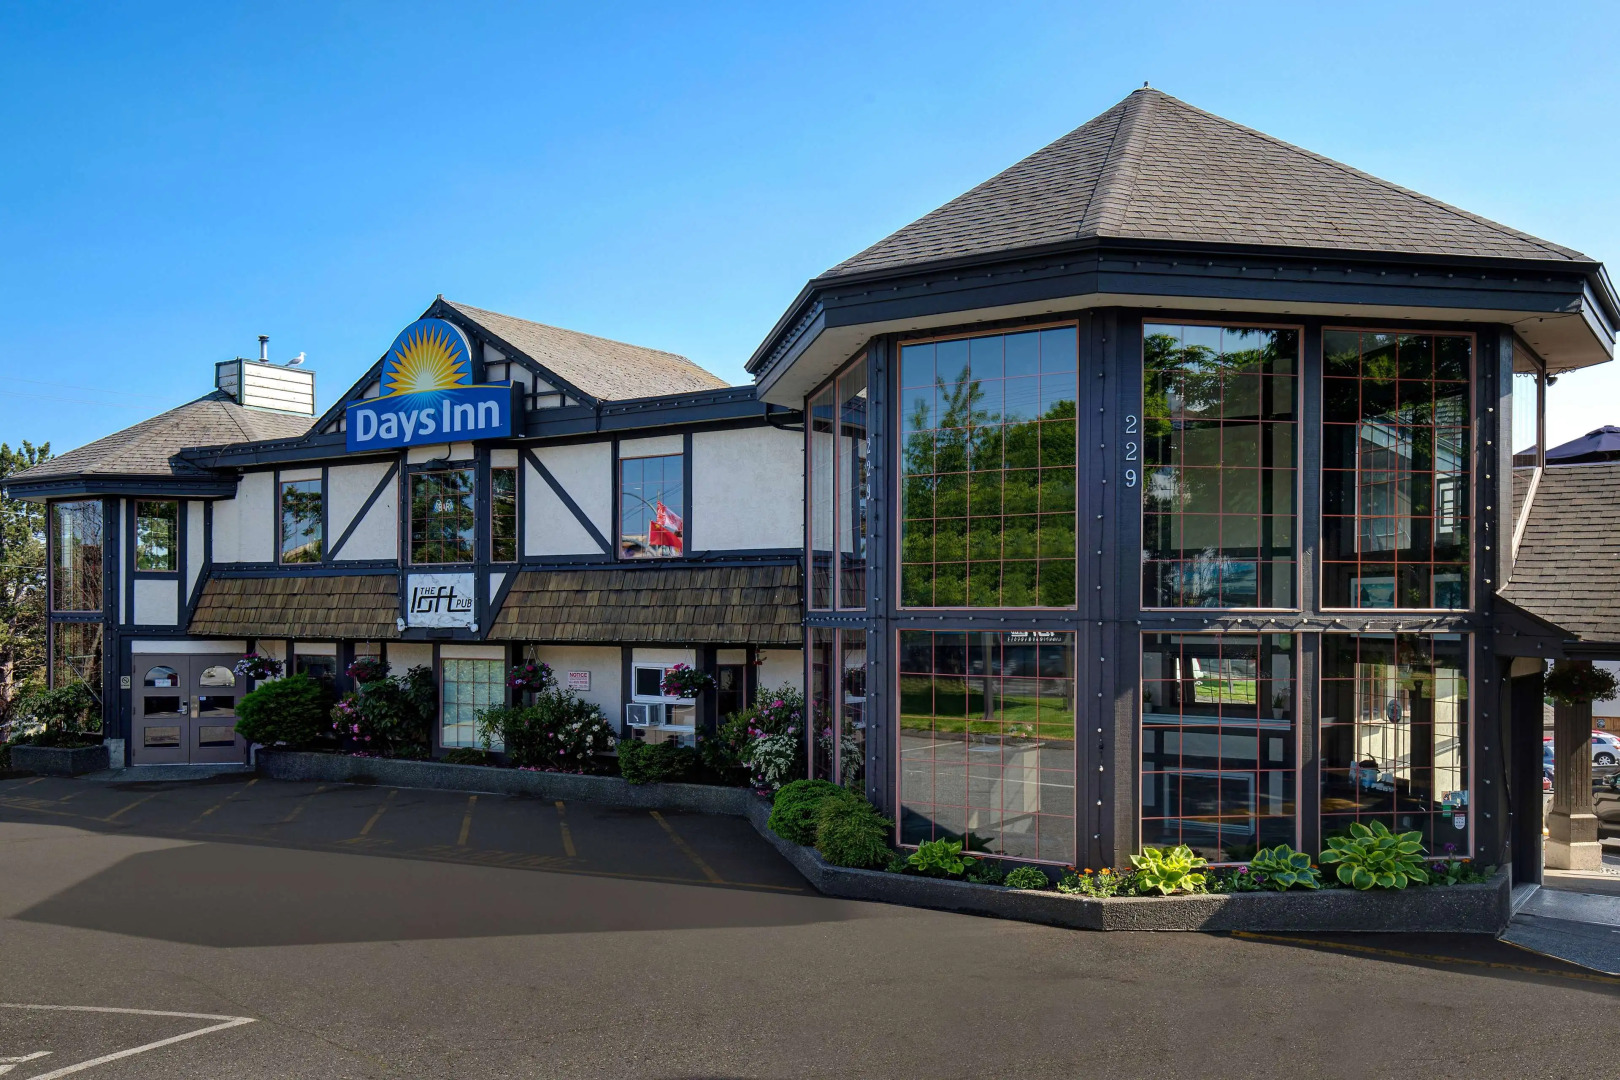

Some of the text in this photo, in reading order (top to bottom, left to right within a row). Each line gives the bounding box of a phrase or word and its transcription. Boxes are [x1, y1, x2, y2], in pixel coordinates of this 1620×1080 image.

[356, 399, 500, 442] Days Inn
[420, 586, 435, 595] THE
[455, 598, 473, 608] PUB
